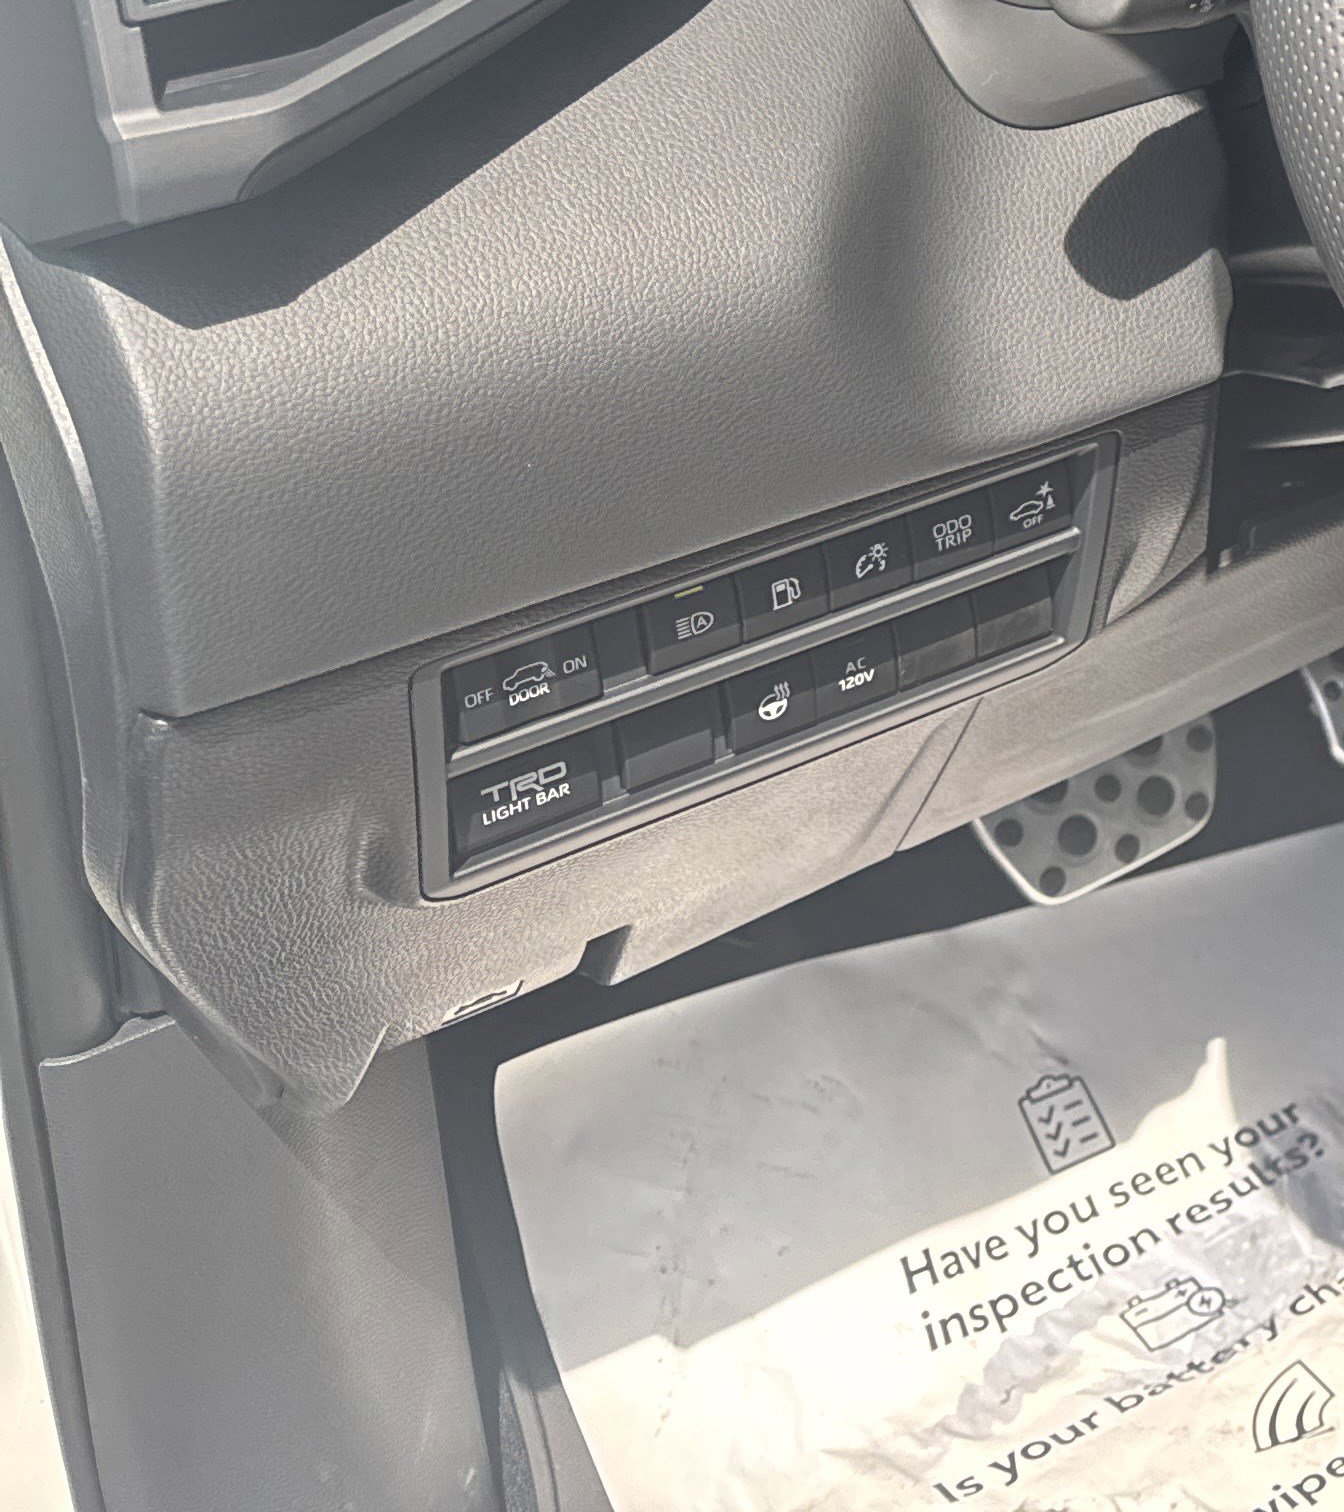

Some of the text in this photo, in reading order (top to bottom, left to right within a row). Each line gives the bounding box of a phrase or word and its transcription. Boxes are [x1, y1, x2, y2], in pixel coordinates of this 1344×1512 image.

[932, 514, 972, 539] ODO
[1022, 513, 1044, 528] OFF
[935, 528, 973, 552] TRIP
[563, 654, 588, 675] ON
[845, 656, 868, 674] AC
[838, 668, 875, 692] 120V
[464, 687, 495, 709] OFF
[508, 682, 551, 707] DOOR
[480, 761, 568, 803] TRD
[482, 782, 571, 826] LIGHT BAR
[900, 1102, 1299, 1295] Have you seen your
[920, 1131, 1325, 1352] inspection results?
[933, 1472, 984, 1504] Is
[987, 1409, 1100, 1486] your
[1103, 1314, 1279, 1414] battery
